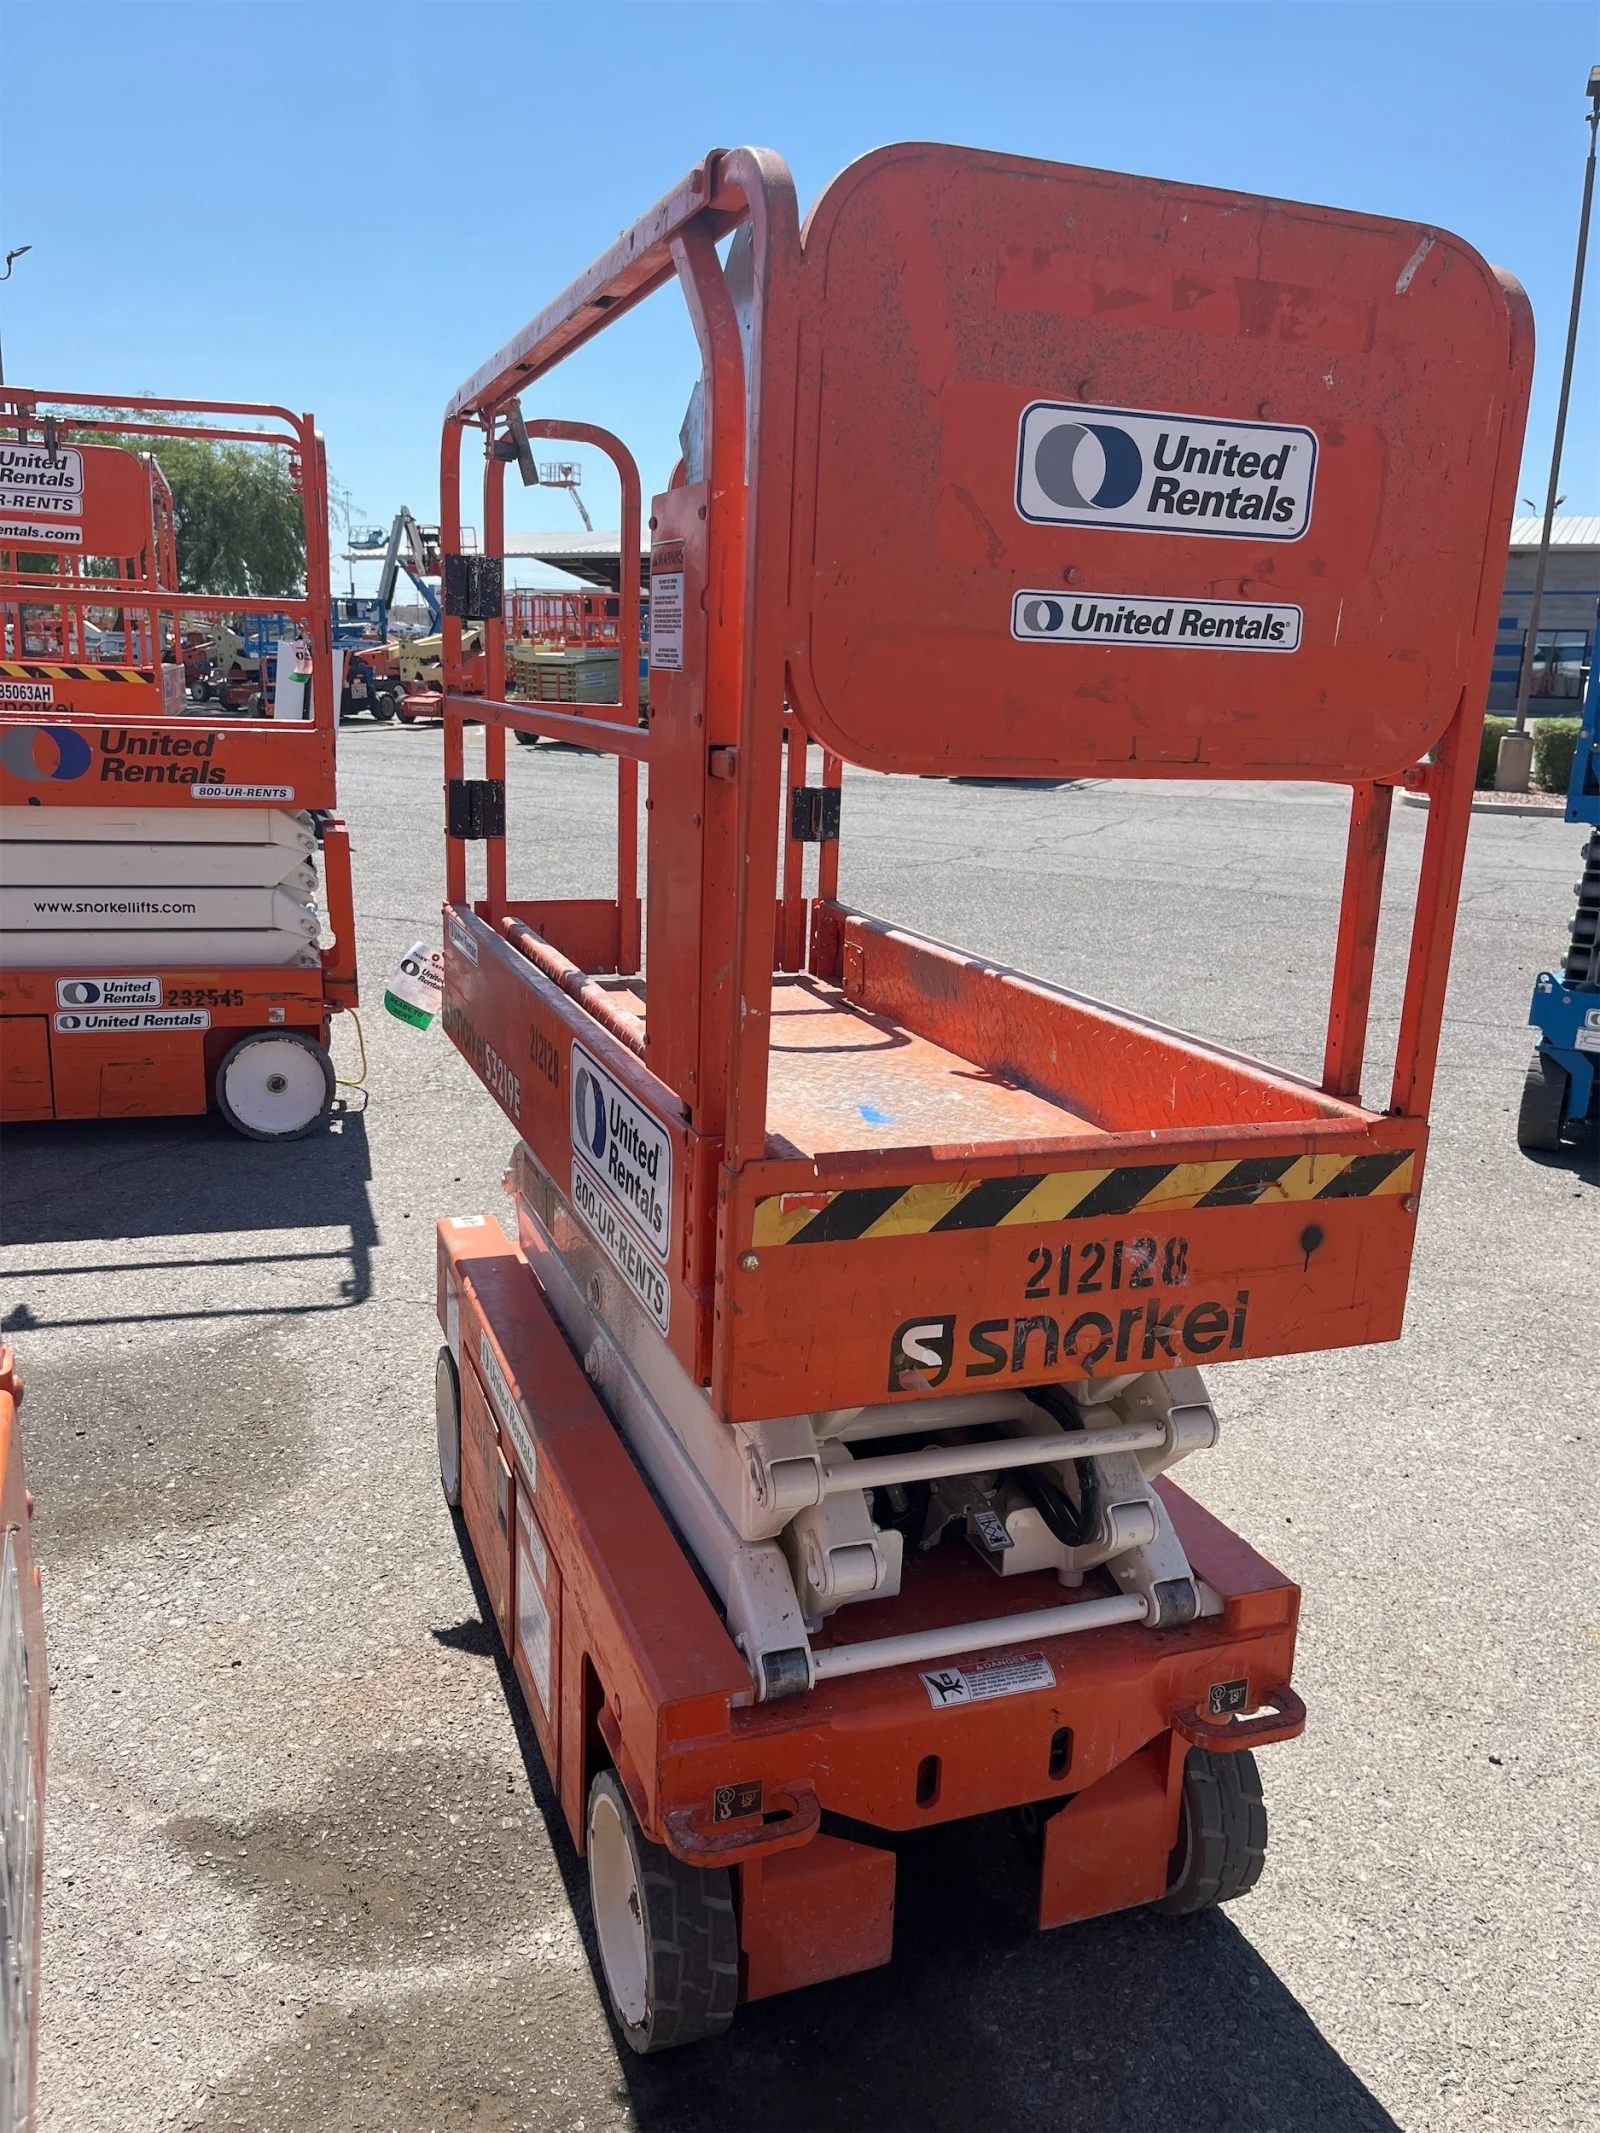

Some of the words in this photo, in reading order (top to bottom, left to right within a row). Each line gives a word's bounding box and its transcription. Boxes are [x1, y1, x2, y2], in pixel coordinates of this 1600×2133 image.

[0, 451, 68, 470] United
[1153, 433, 1291, 480] United
[0, 468, 75, 488] Rentals
[1147, 476, 1296, 523] Rentals
[1071, 603, 1174, 636] United
[1178, 609, 1286, 641] Rentals
[101, 730, 215, 757] United
[101, 758, 226, 784] Rentals
[199, 787, 287, 798] 800-UR-RENTS
[34, 902, 196, 913] www.snorkellifts.com
[103, 981, 151, 992] United
[103, 993, 156, 1004] Rentals
[168, 989, 244, 1007] 232545
[85, 1015, 139, 1028] United
[144, 1013, 202, 1026] Rentals
[529, 1024, 560, 1089] 212128
[486, 1043, 521, 1121] S3219E
[609, 1098, 660, 1182] United
[608, 1139, 663, 1235] Rentals
[575, 1173, 664, 1316] 800-UR-RENTS
[1024, 1236, 1190, 1299] 212128
[489, 1361, 509, 1416] United
[509, 1401, 534, 1475] Rentals
[982, 1656, 1029, 1669] DANGER
